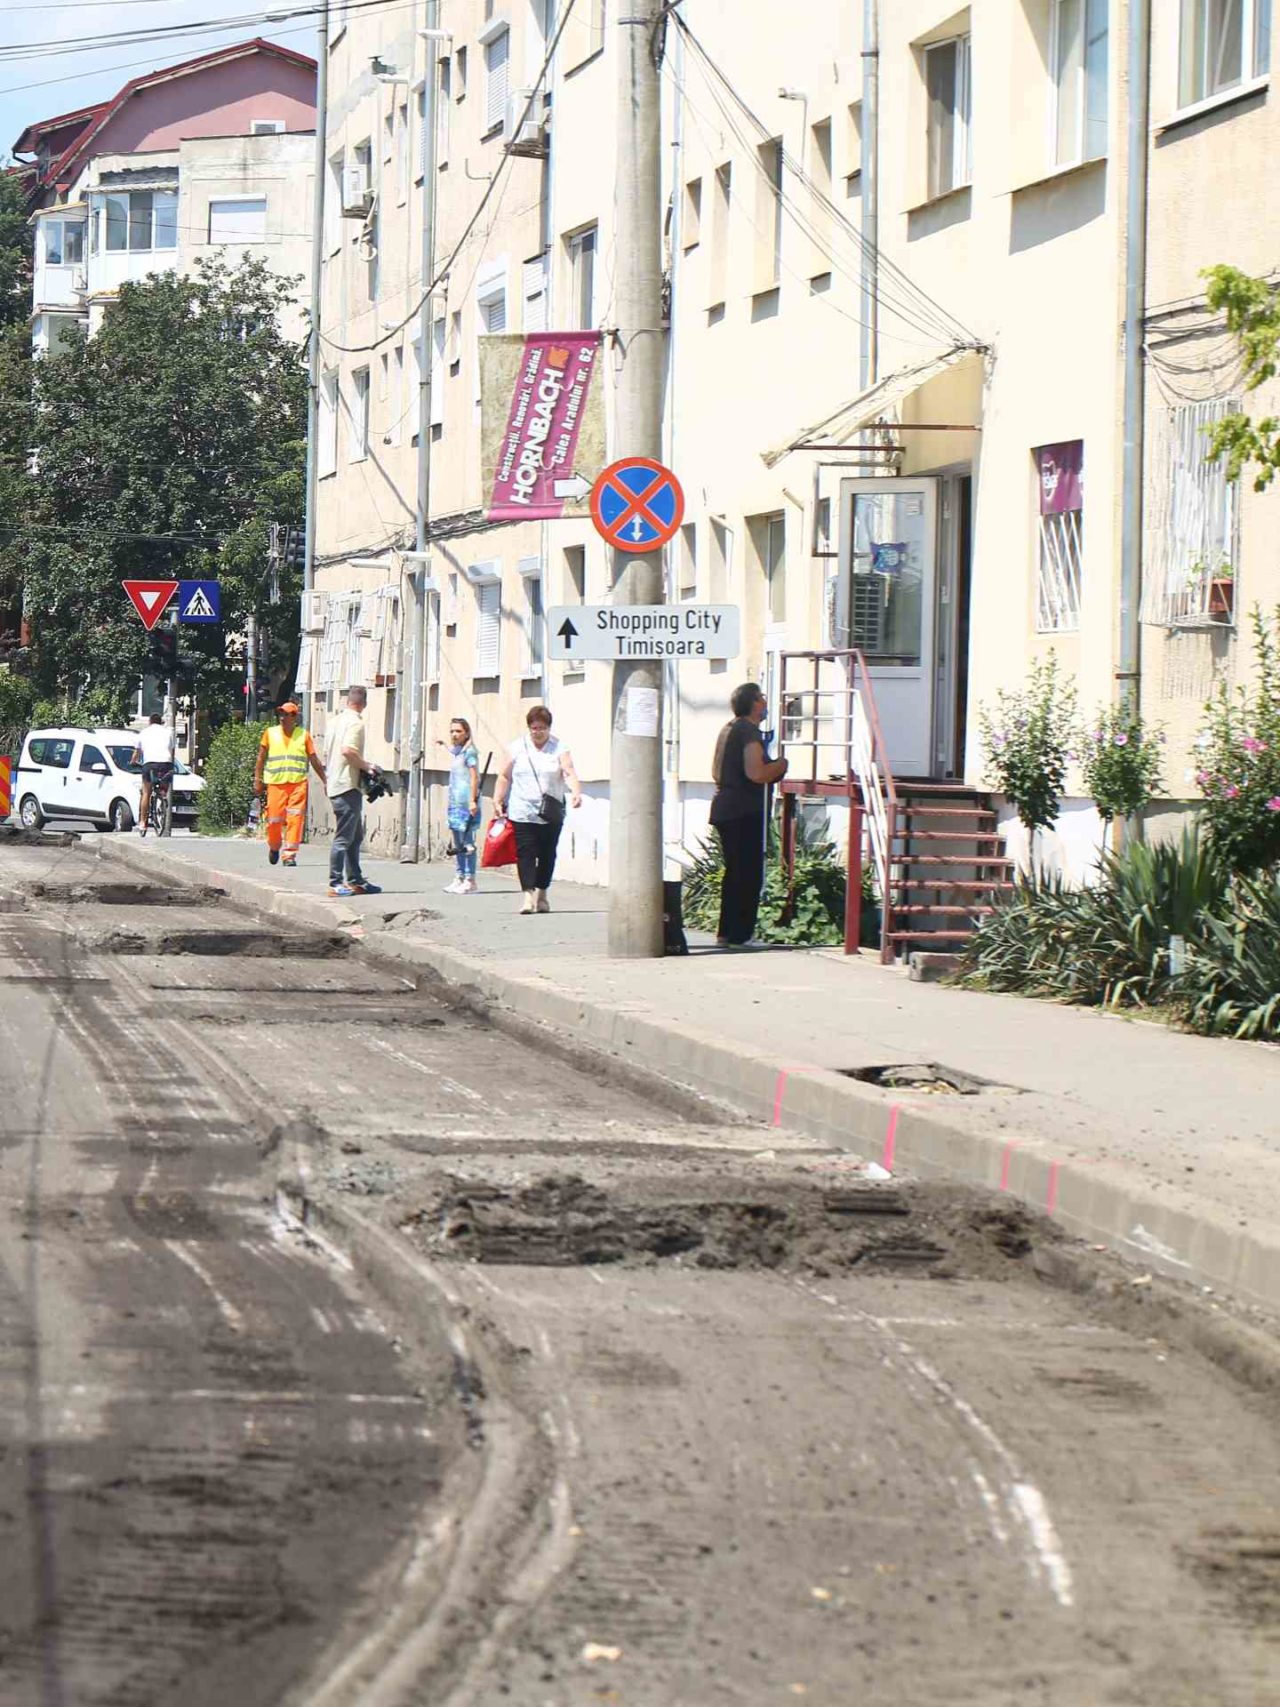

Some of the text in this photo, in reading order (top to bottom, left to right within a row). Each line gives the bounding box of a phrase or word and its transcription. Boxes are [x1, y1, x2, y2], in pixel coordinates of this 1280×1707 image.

[509, 368, 564, 504] HORNBACH
[552, 347, 594, 464] Calea Aradului nr. 62
[596, 610, 722, 635] Shopping City
[615, 636, 705, 658] Timișoara
